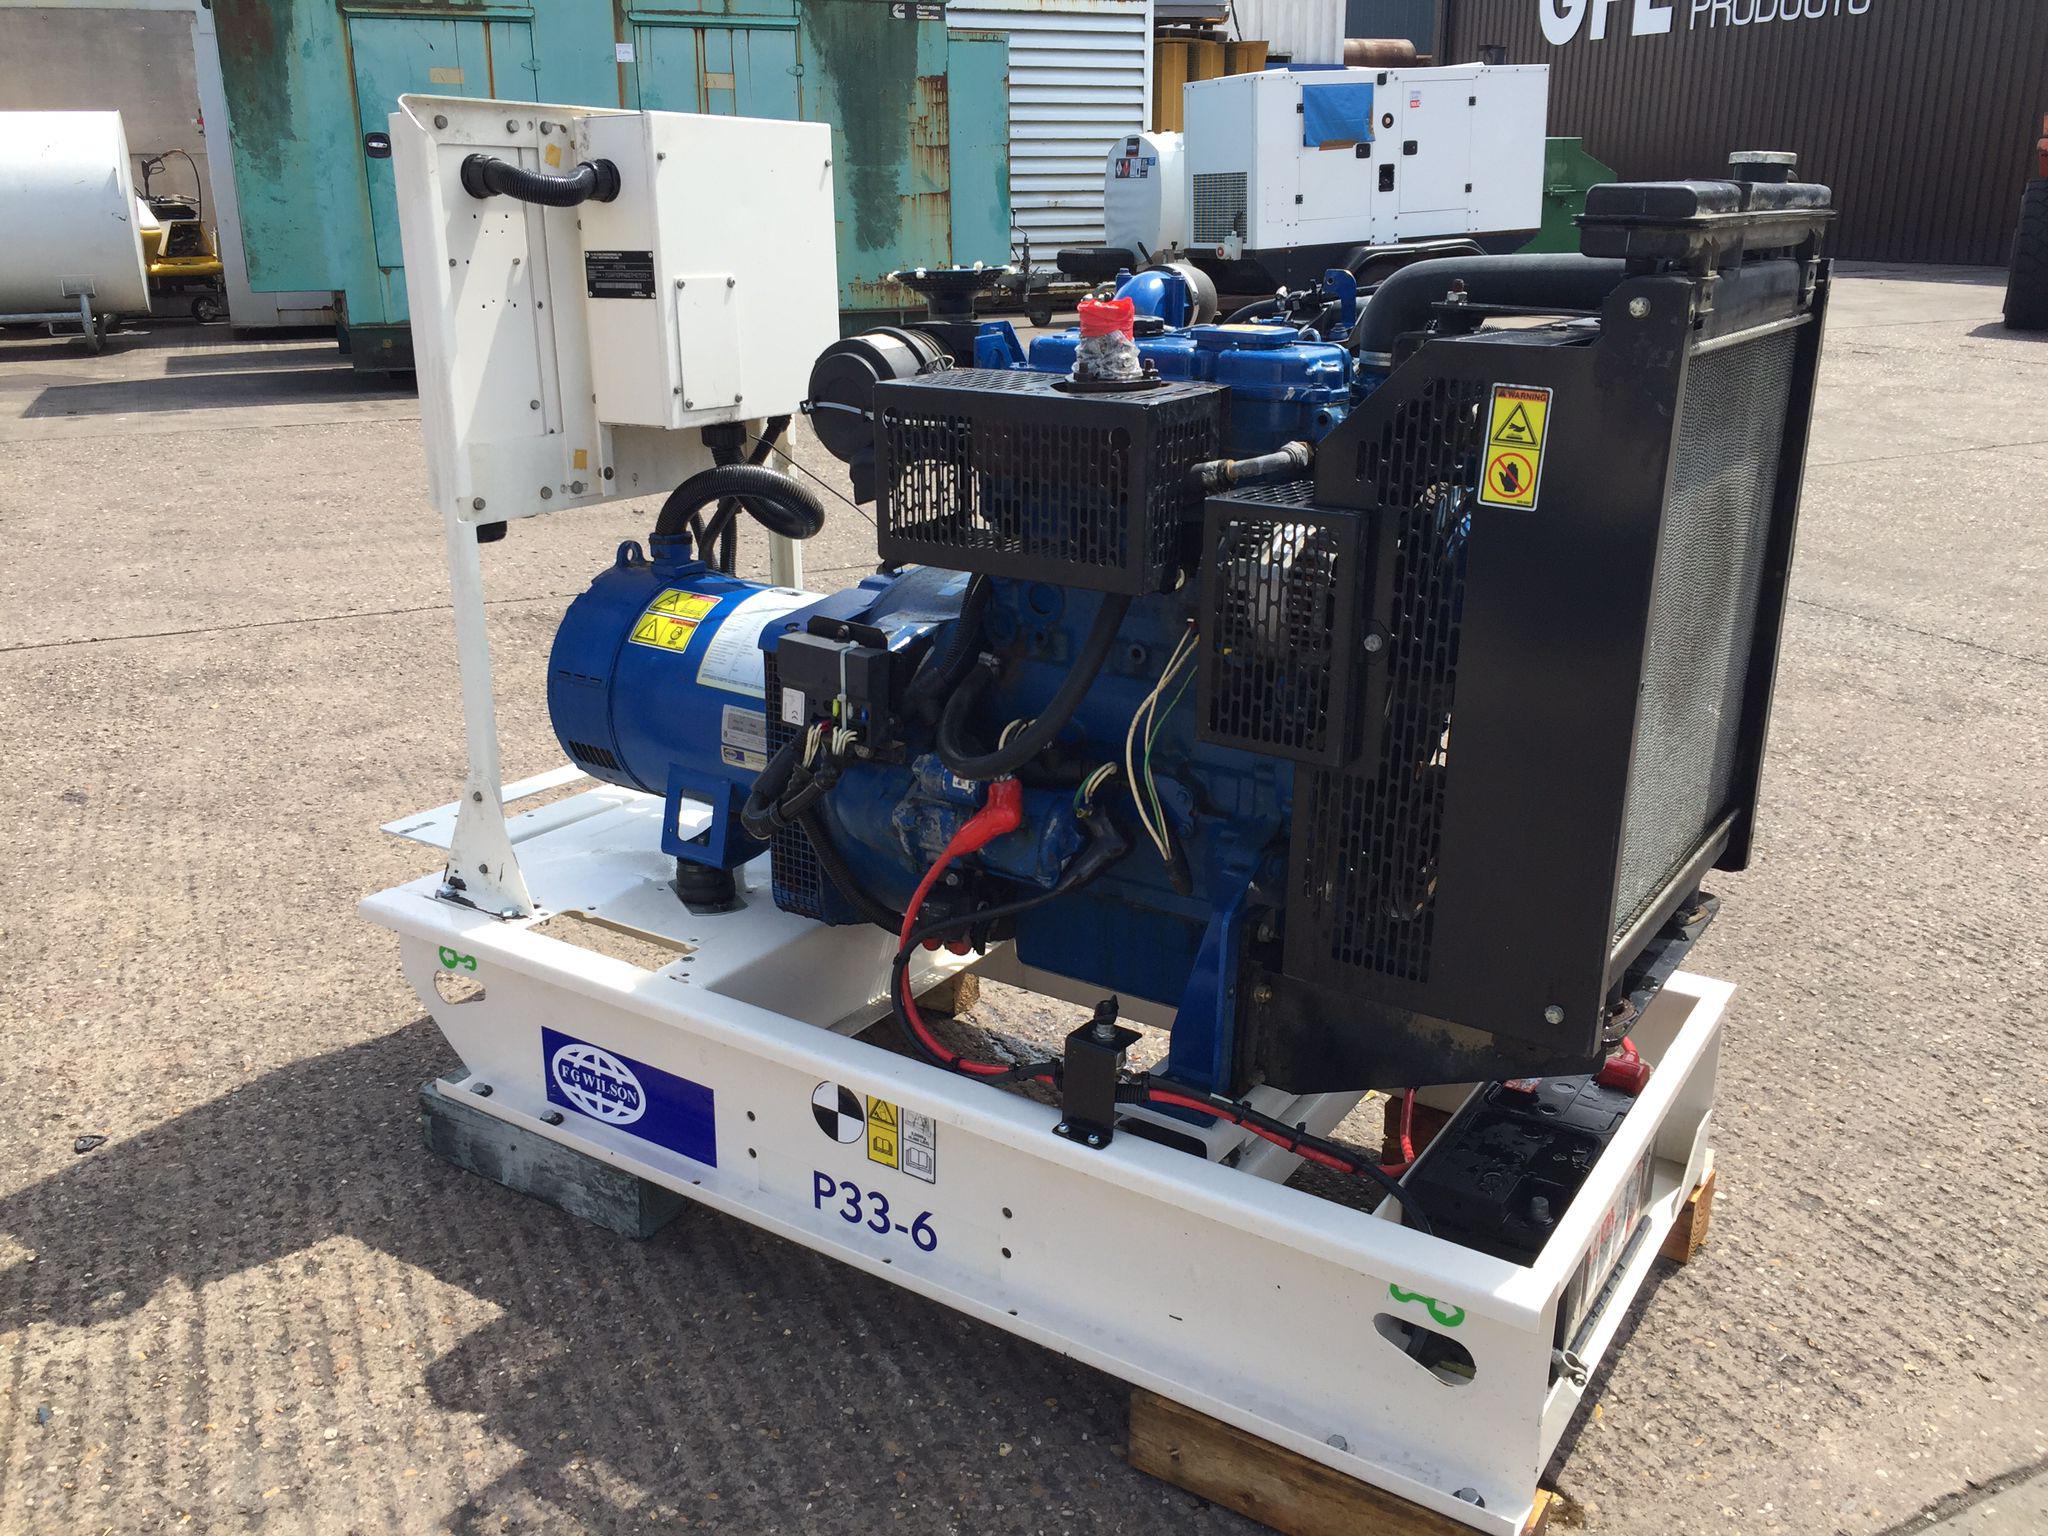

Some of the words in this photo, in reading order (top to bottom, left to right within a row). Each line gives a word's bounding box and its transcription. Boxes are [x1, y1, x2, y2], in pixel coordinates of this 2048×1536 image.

[1508, 391, 1547, 402] WARNING
[582, 1072, 637, 1105] WILSON
[813, 1170, 938, 1252] P33-6
